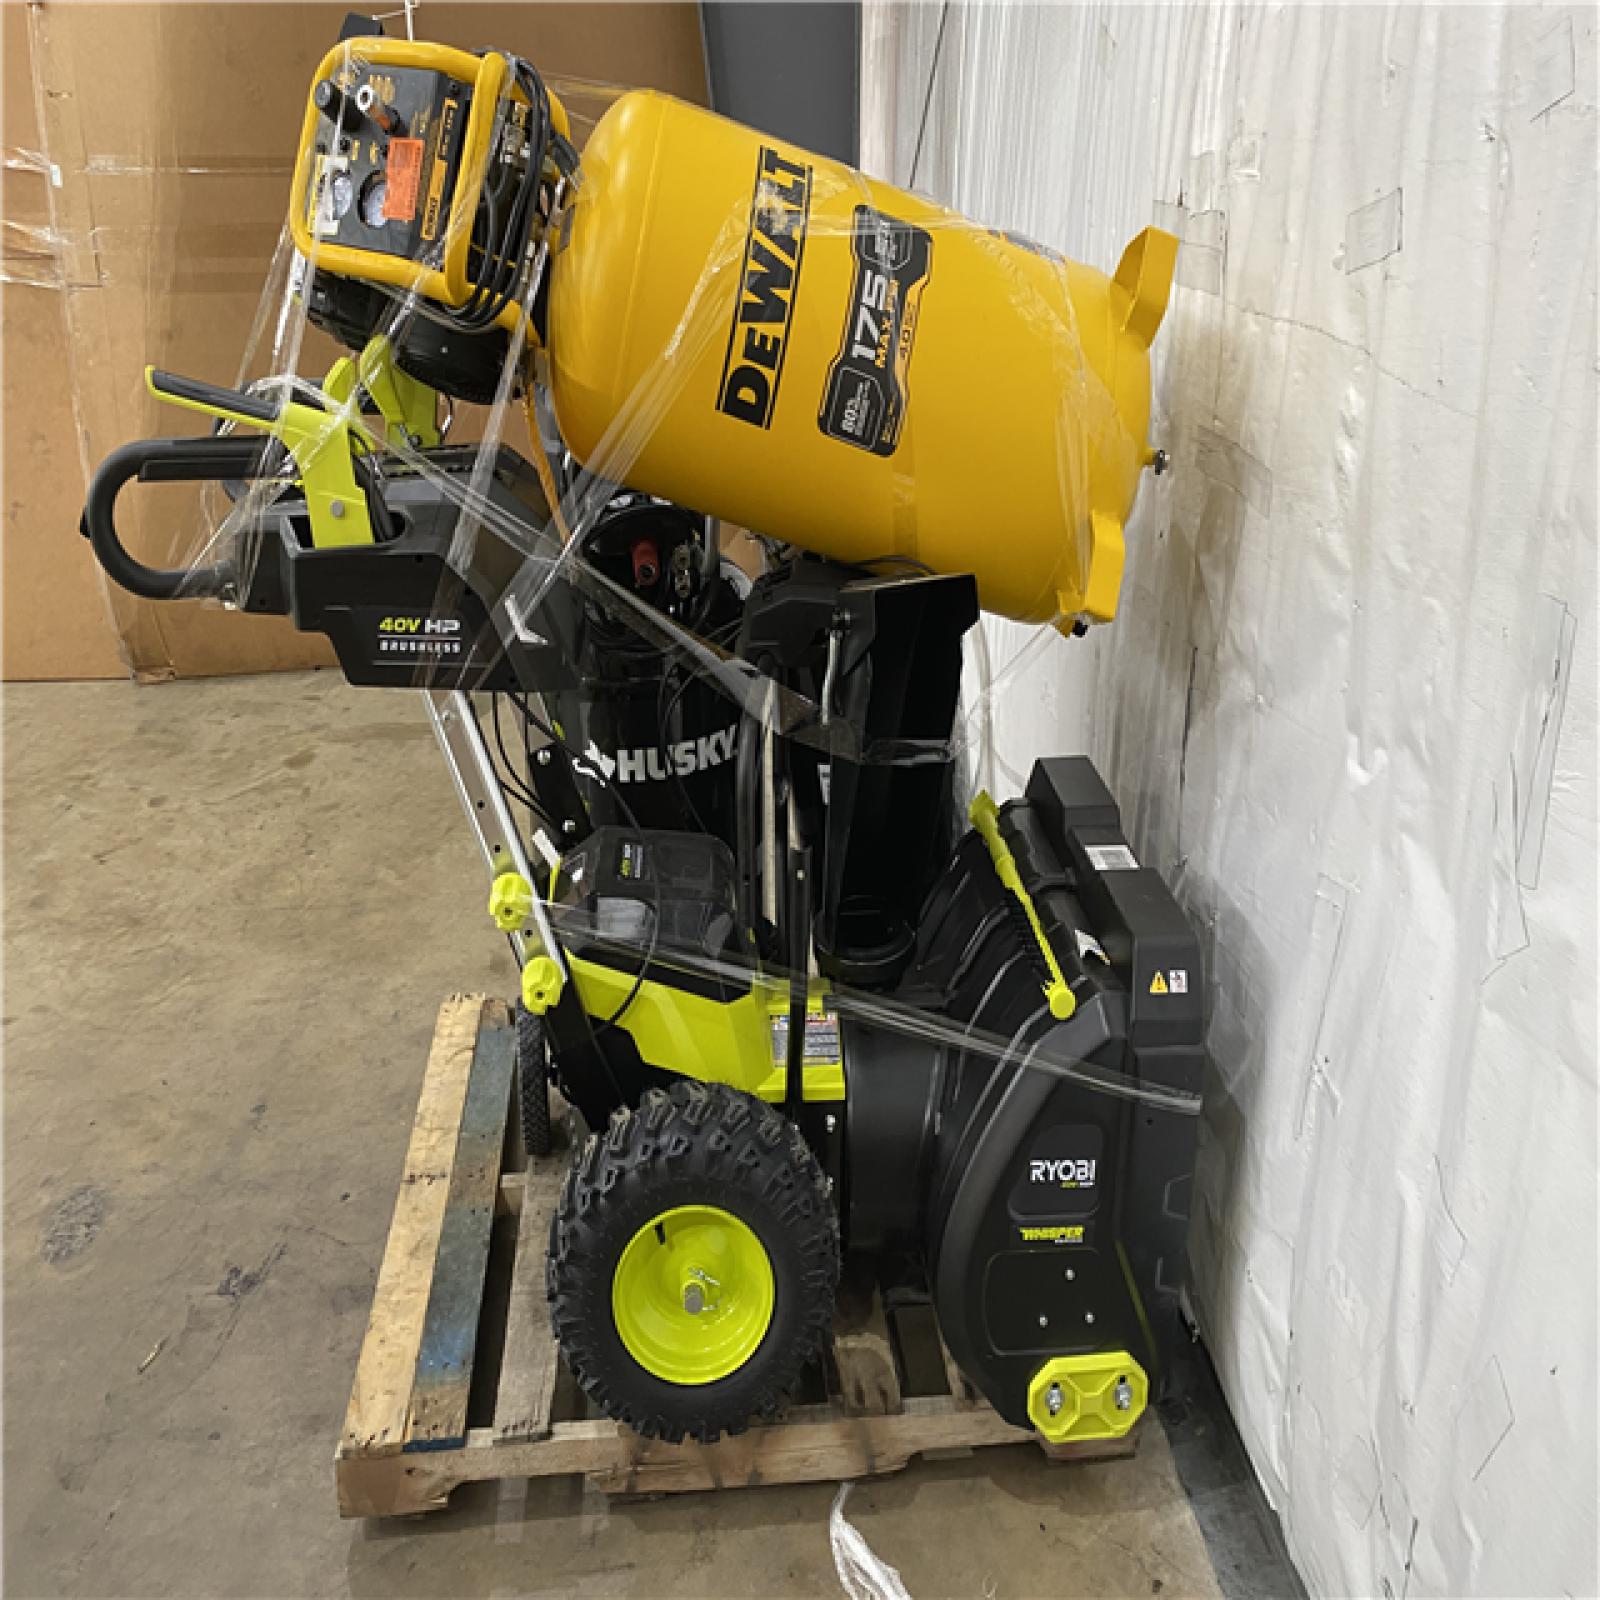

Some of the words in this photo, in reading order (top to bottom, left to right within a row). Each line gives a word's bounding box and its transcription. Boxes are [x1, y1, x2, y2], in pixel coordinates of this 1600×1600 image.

[722, 148, 806, 428] DEWALT
[852, 269, 887, 360] 175
[875, 316, 892, 368] MAX
[379, 616, 421, 633] 40V
[424, 617, 461, 634] HP
[379, 640, 461, 654] BRUSHLESS
[616, 723, 738, 784] HUSKY
[1029, 1159, 1096, 1183] RYOBI
